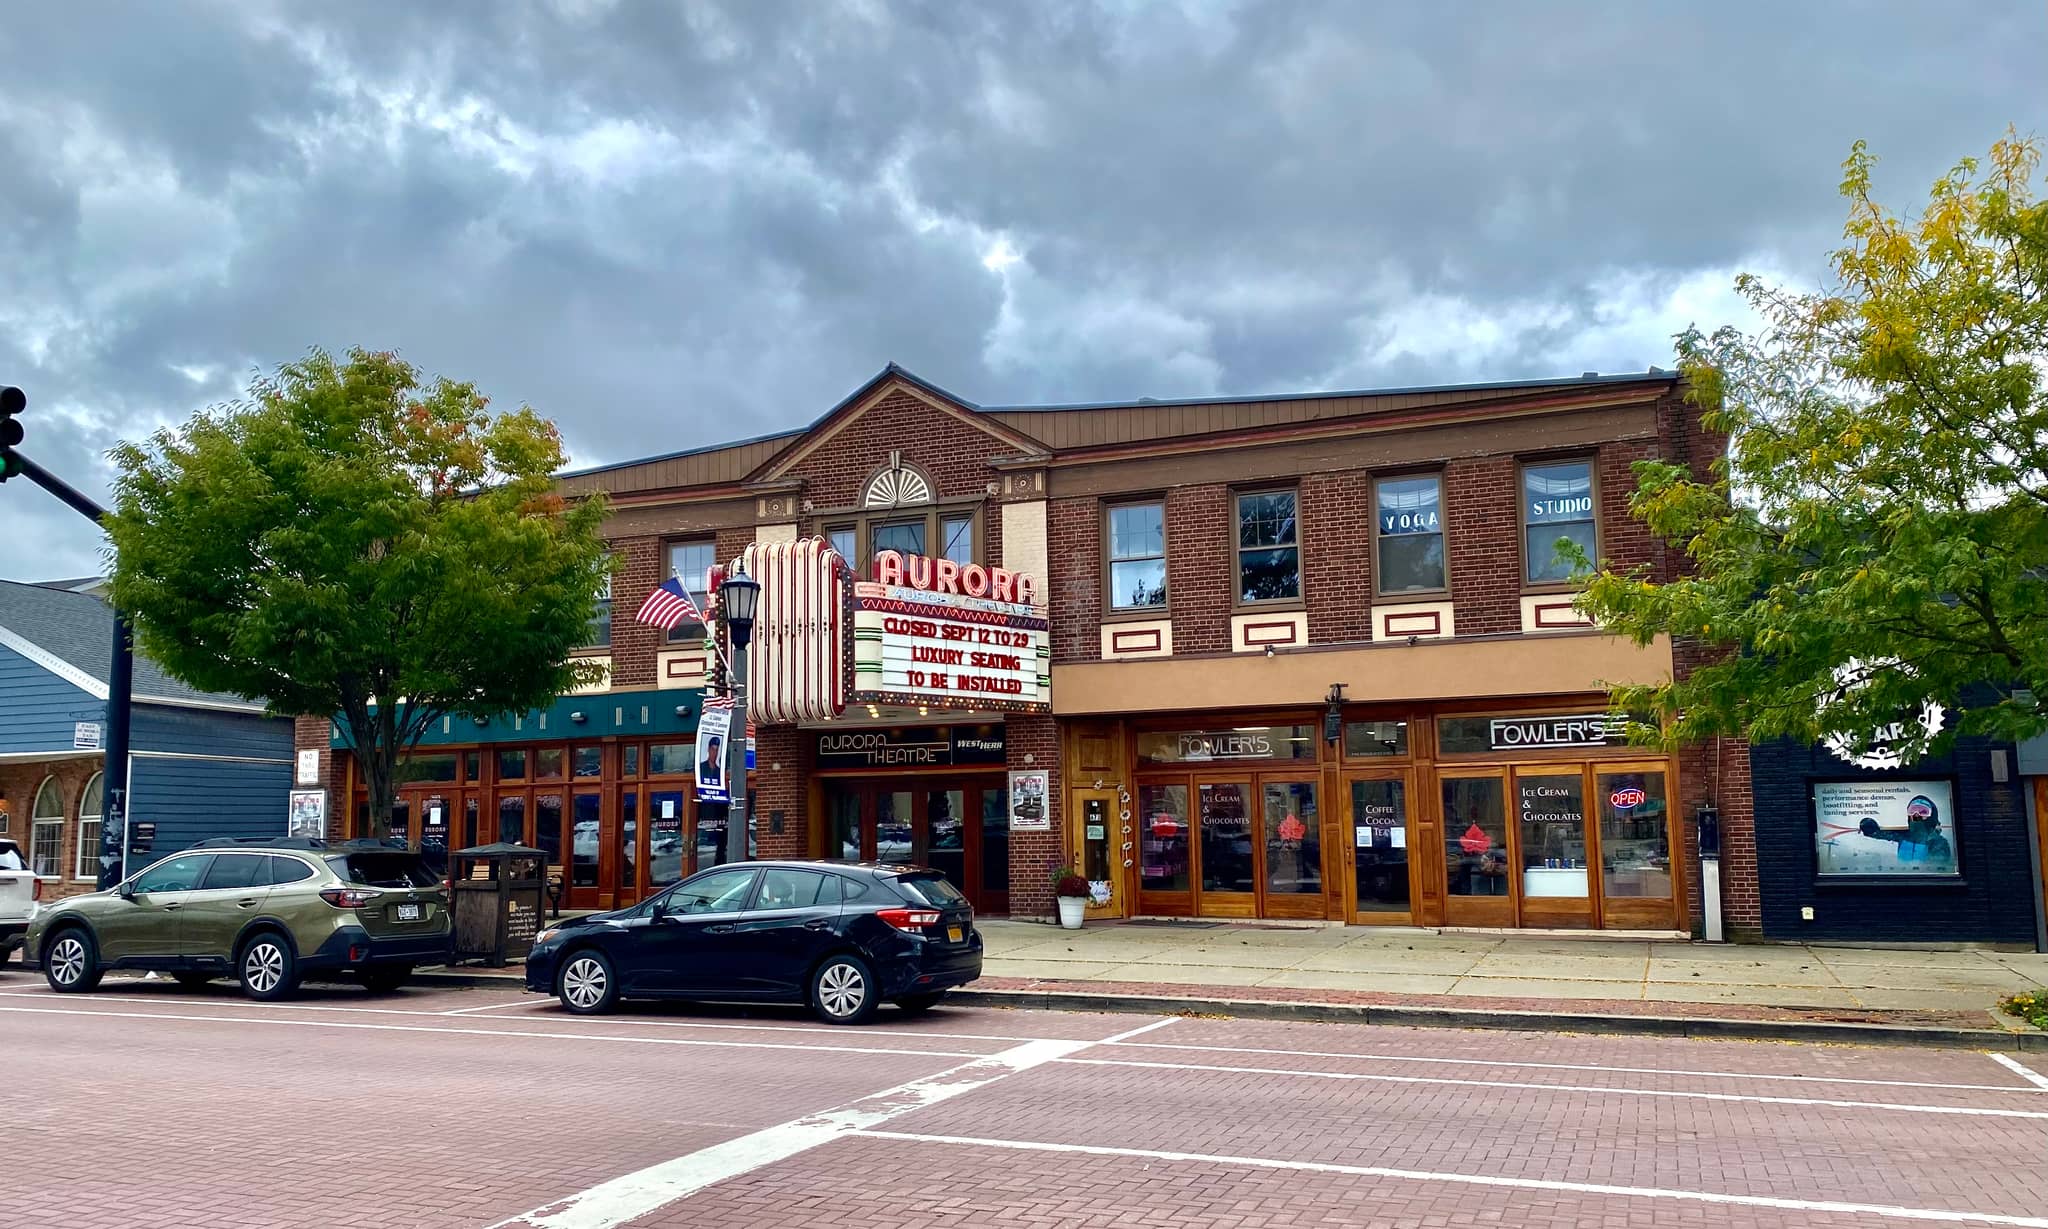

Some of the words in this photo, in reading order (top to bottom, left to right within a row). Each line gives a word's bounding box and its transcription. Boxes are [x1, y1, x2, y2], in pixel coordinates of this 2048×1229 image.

[1533, 497, 1592, 516] STUDIO
[1385, 511, 1439, 530] YOGA
[877, 549, 1040, 604] AURORA
[884, 617, 937, 638] CLOSED
[941, 624, 975, 643] SEPT
[978, 628, 991, 645] 12
[993, 630, 1010, 646] TO
[1013, 632, 1029, 648] 29
[912, 645, 964, 666] LUXURY
[970, 651, 1021, 671] SEATING
[906, 670, 925, 688] TO
[931, 673, 948, 689] BE
[957, 674, 1023, 694] INSTALLED
[1490, 719, 1609, 746] FOWLER'S
[820, 734, 887, 751] AURORA
[957, 740, 981, 748] WEST
[867, 745, 937, 765] THEATRE
[1214, 792, 1241, 803] CREAM
[1522, 787, 1536, 797] ICE
[1537, 786, 1569, 797] CREAM
[1610, 791, 1645, 807] OPEN
[1202, 805, 1210, 813] &
[1522, 800, 1531, 809] &
[1203, 815, 1250, 826] CHOCOLATES
[1523, 811, 1582, 822] CHOCOLATES
